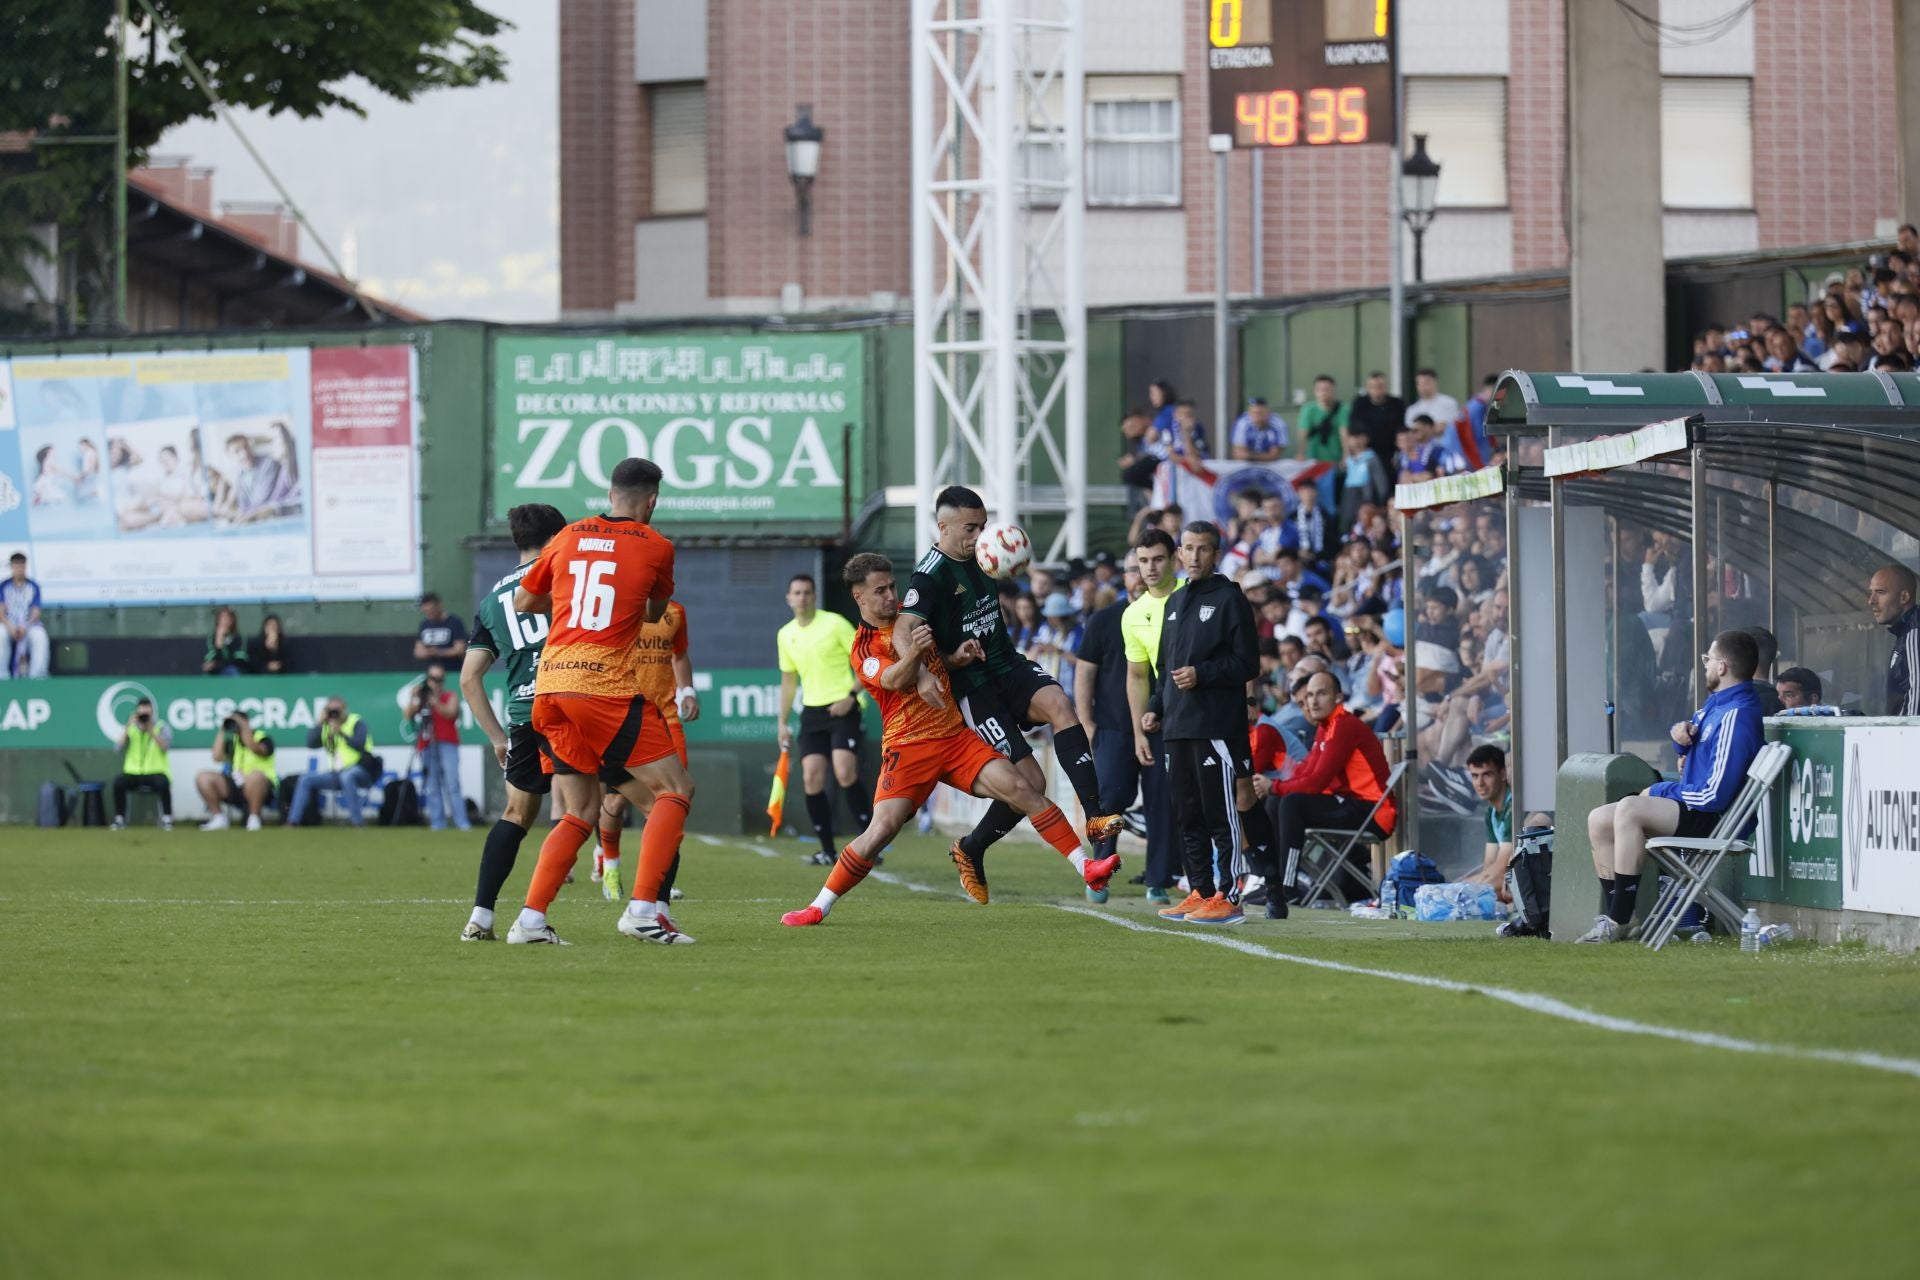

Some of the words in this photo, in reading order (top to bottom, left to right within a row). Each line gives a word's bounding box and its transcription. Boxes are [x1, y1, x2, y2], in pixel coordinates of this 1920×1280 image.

[515, 393, 697, 414] DECORACIONES
[700, 392, 716, 413] Y
[719, 391, 846, 413] REFORMAS
[513, 416, 844, 490] ZOGSA
[498, 589, 550, 651] 15
[566, 560, 617, 632] 16
[0, 697, 51, 731] AP
[978, 716, 1006, 746] 18
[1866, 790, 1920, 852] AUTONE
